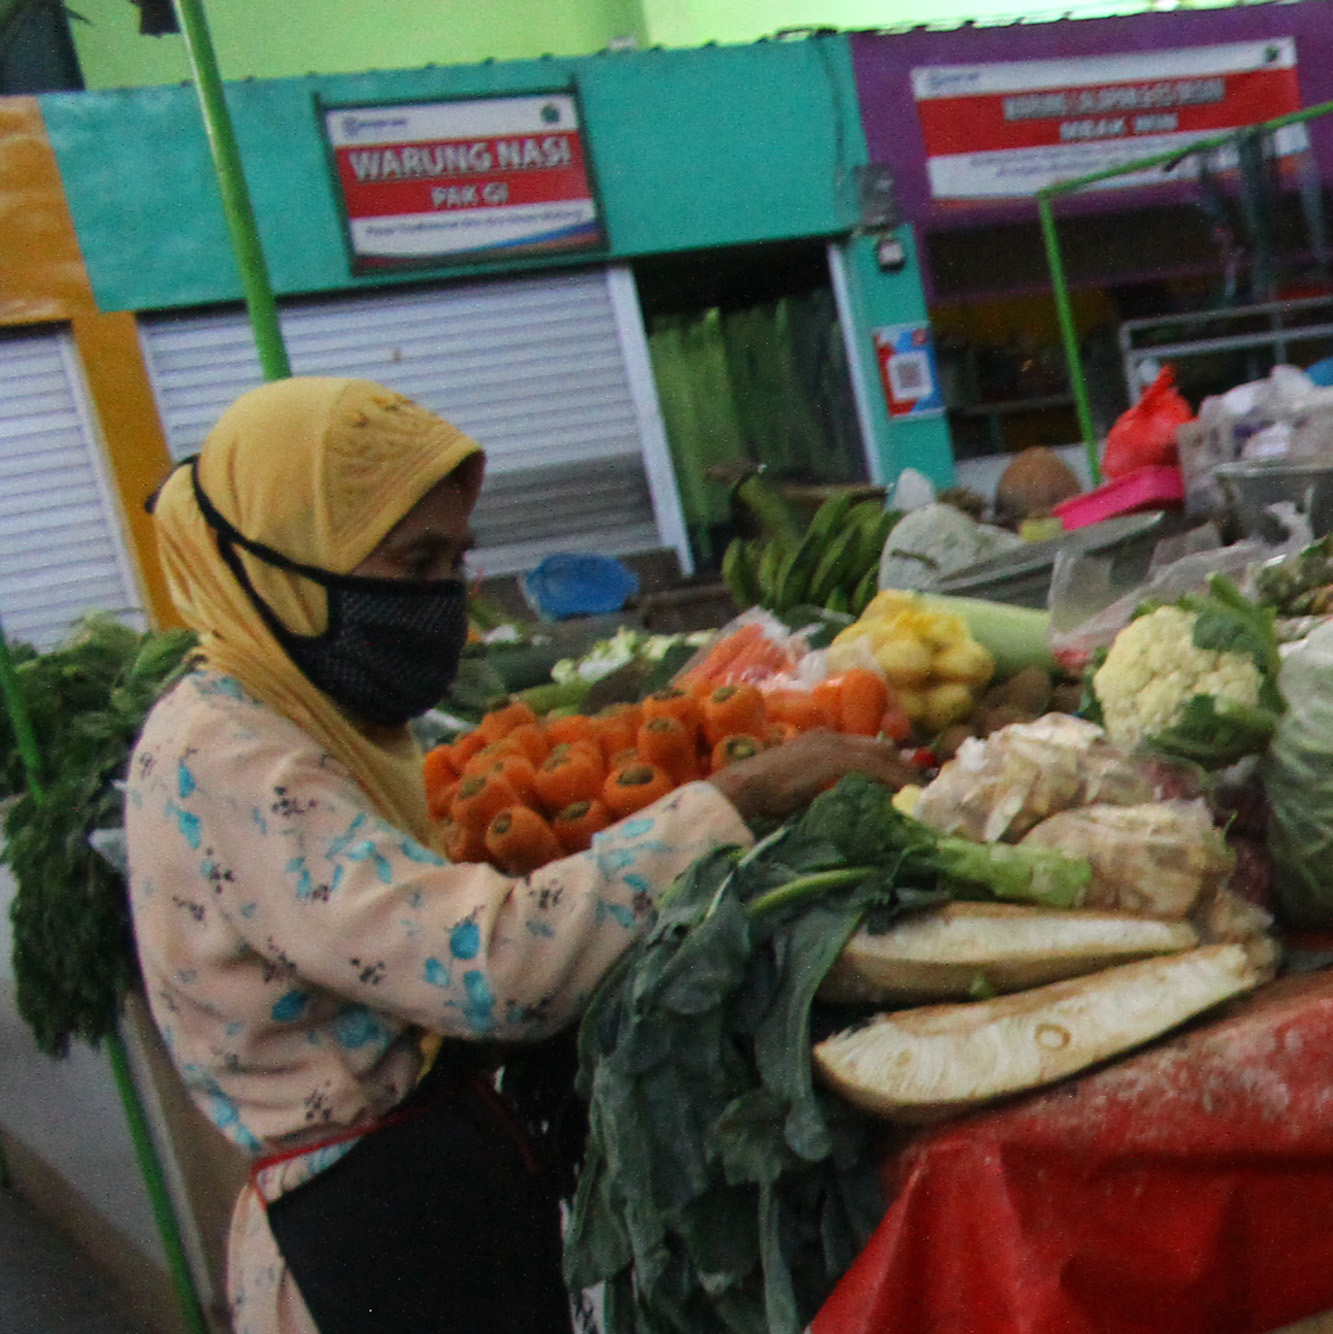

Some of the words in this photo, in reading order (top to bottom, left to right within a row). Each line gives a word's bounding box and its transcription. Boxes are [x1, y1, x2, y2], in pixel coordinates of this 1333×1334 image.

[348, 142, 493, 182] WARUNG
[496, 136, 573, 170] NASI
[430, 184, 479, 209] PAK
